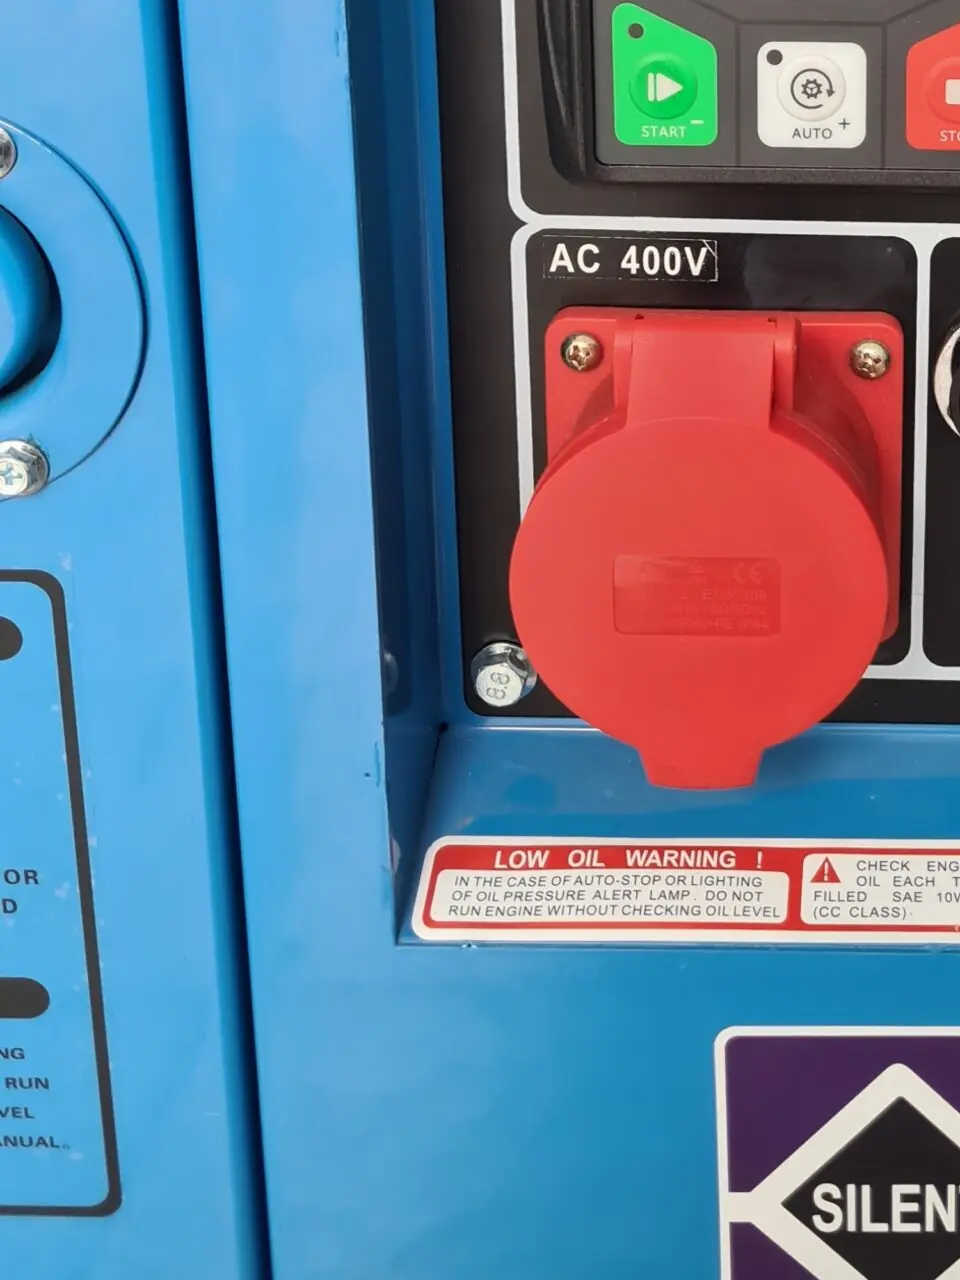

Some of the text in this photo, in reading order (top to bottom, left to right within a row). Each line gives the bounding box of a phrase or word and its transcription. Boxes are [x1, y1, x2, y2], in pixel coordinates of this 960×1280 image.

[641, 125, 686, 138] START
[792, 128, 832, 140] AUTO
[549, 243, 708, 276] AC 400V
[494, 850, 550, 869] LOW
[567, 849, 606, 867] OIL
[625, 849, 737, 868] WARNING
[856, 860, 911, 872] CHECK
[3, 869, 40, 885] OR
[454, 874, 763, 888] IN THE CASE OF AUTO-STOP OR LIGHTING
[856, 875, 881, 887] OIL
[893, 876, 936, 887] EACH
[451, 890, 473, 902] OF
[476, 890, 499, 902] OIL
[503, 890, 586, 902] PRESSURE
[592, 889, 642, 901] ALERT
[705, 890, 727, 901] DO
[731, 890, 764, 902] NOT
[813, 891, 867, 902] FILLED
[892, 891, 923, 903] SAE
[448, 904, 780, 918] RUN ENGINE WITHOUT CHECKING OIL LEVEL
[813, 906, 841, 920] (CC
[5, 1077, 50, 1090] RUN
